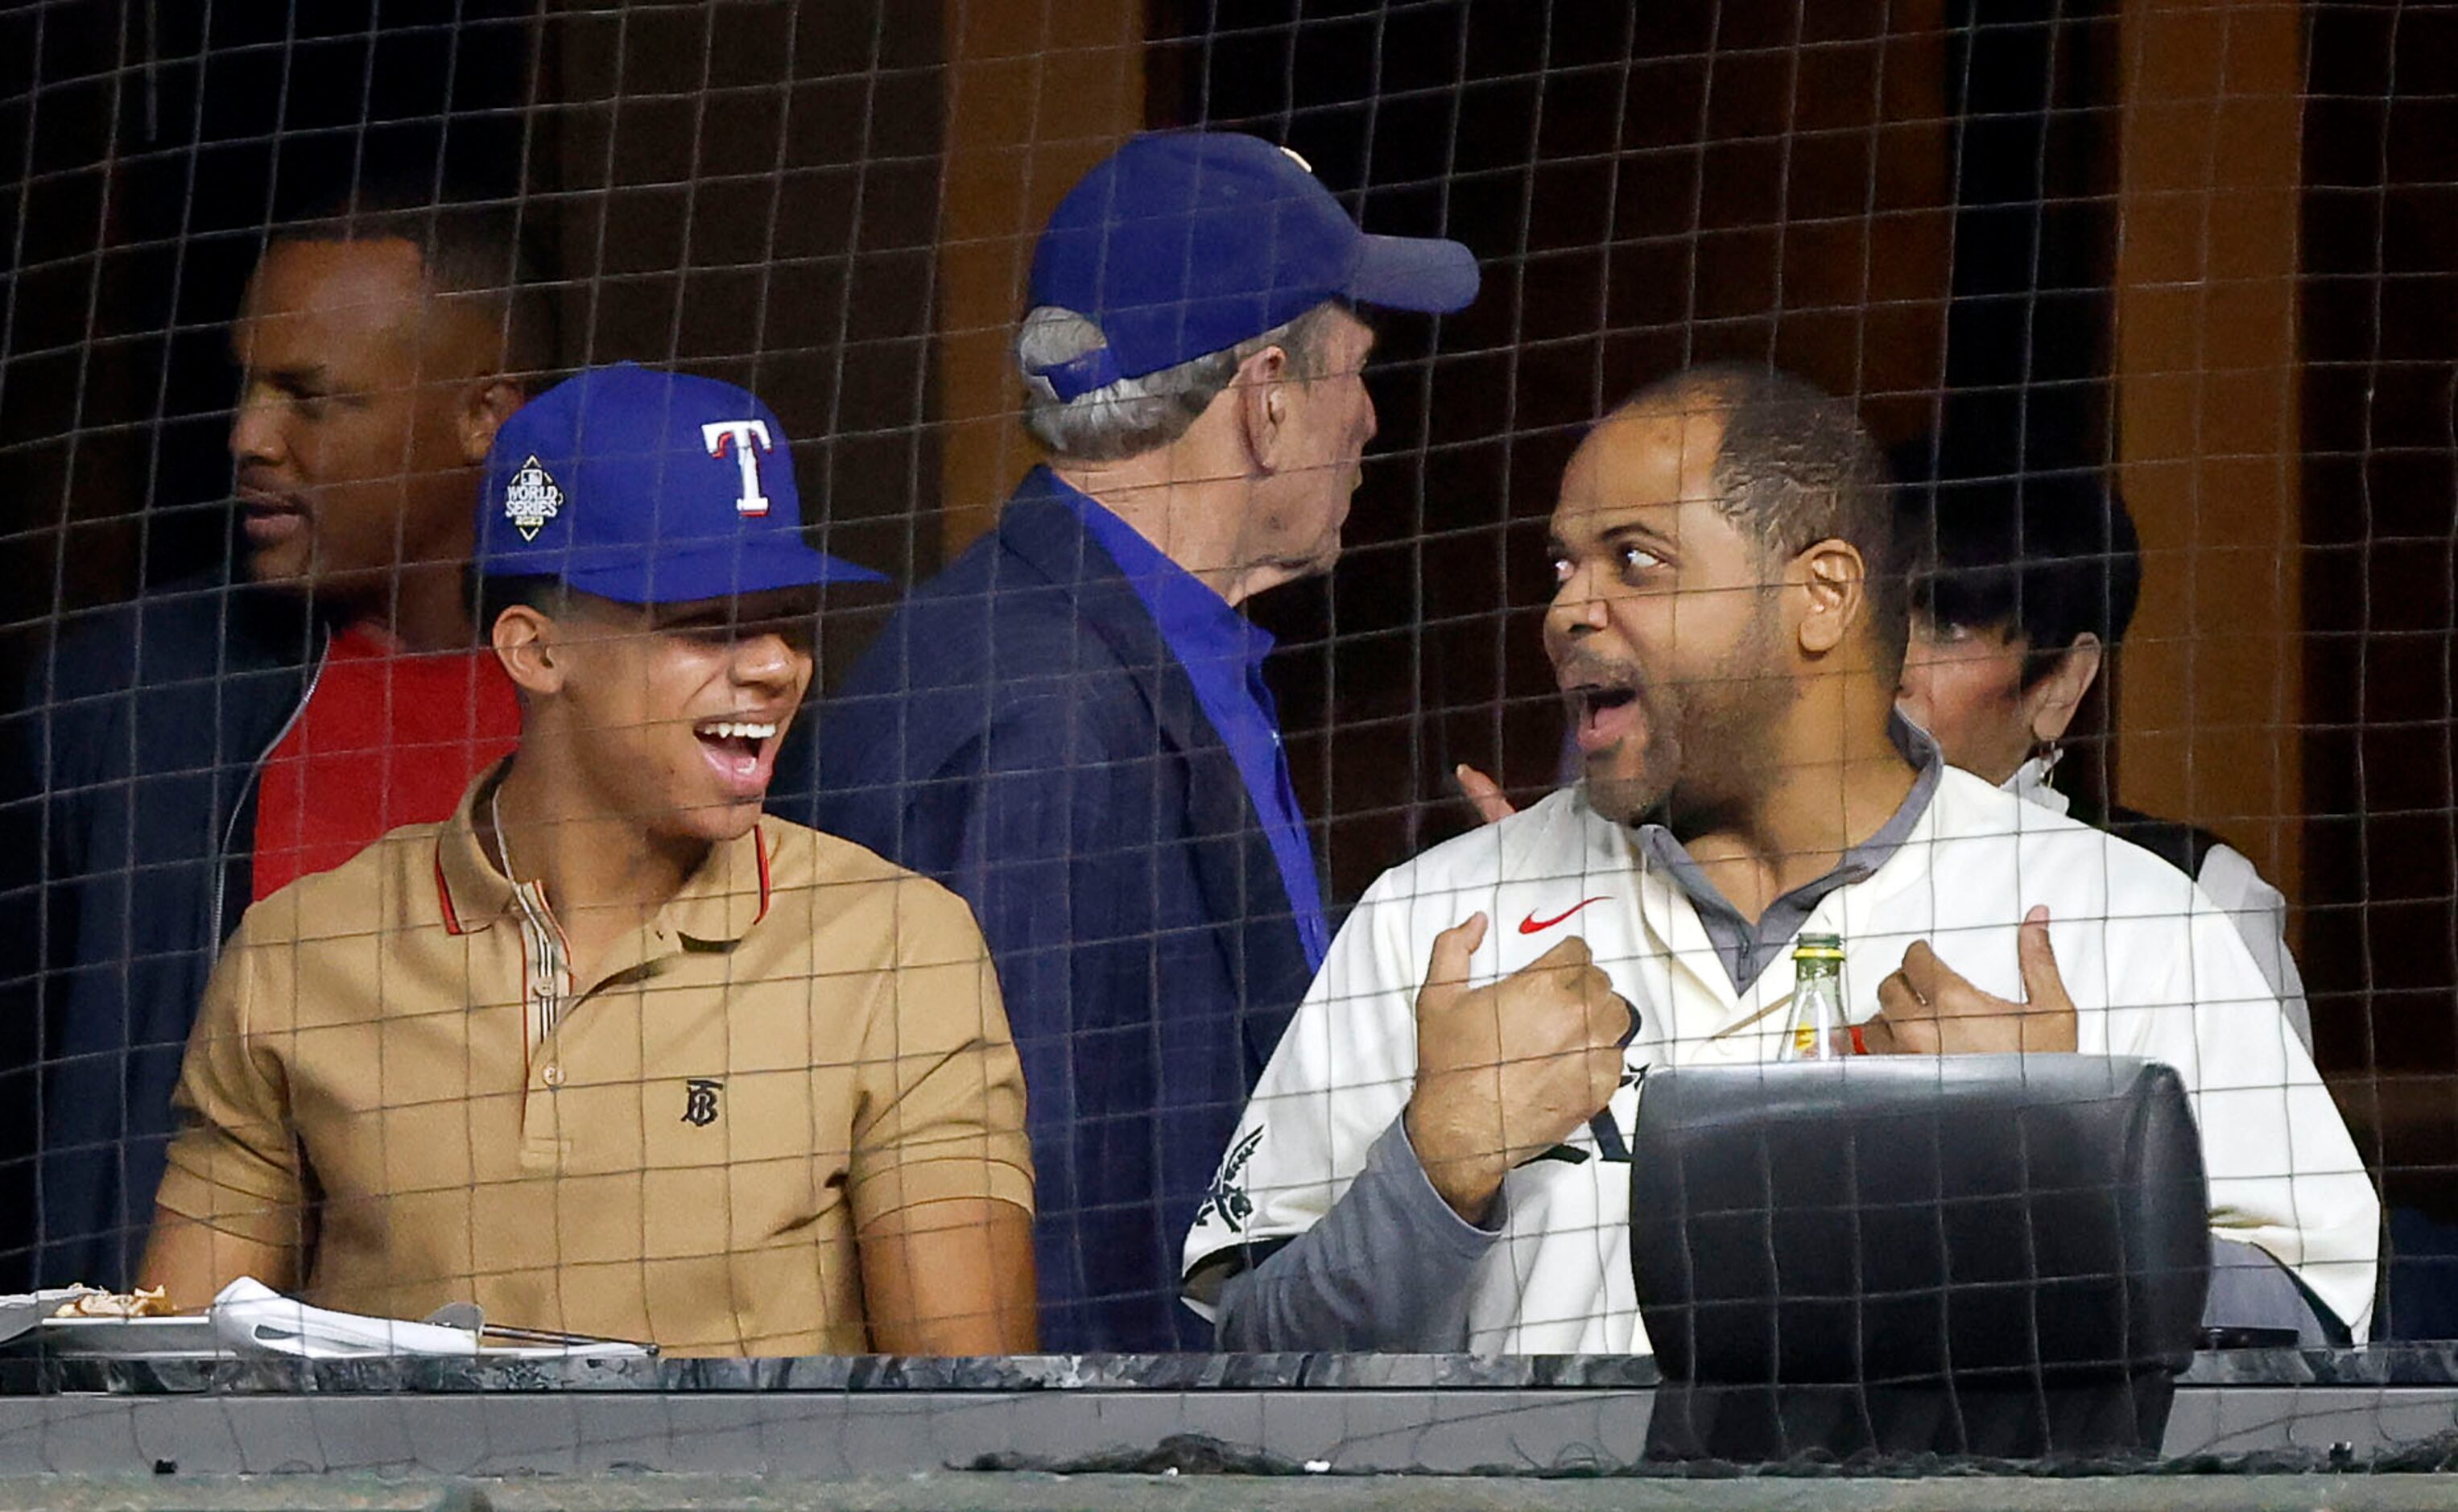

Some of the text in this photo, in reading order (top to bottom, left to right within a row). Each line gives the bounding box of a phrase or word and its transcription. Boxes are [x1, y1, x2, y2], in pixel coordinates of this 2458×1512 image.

[701, 419, 773, 517] T
[507, 485, 559, 501] WORLD
[506, 500, 558, 518] SERIES
